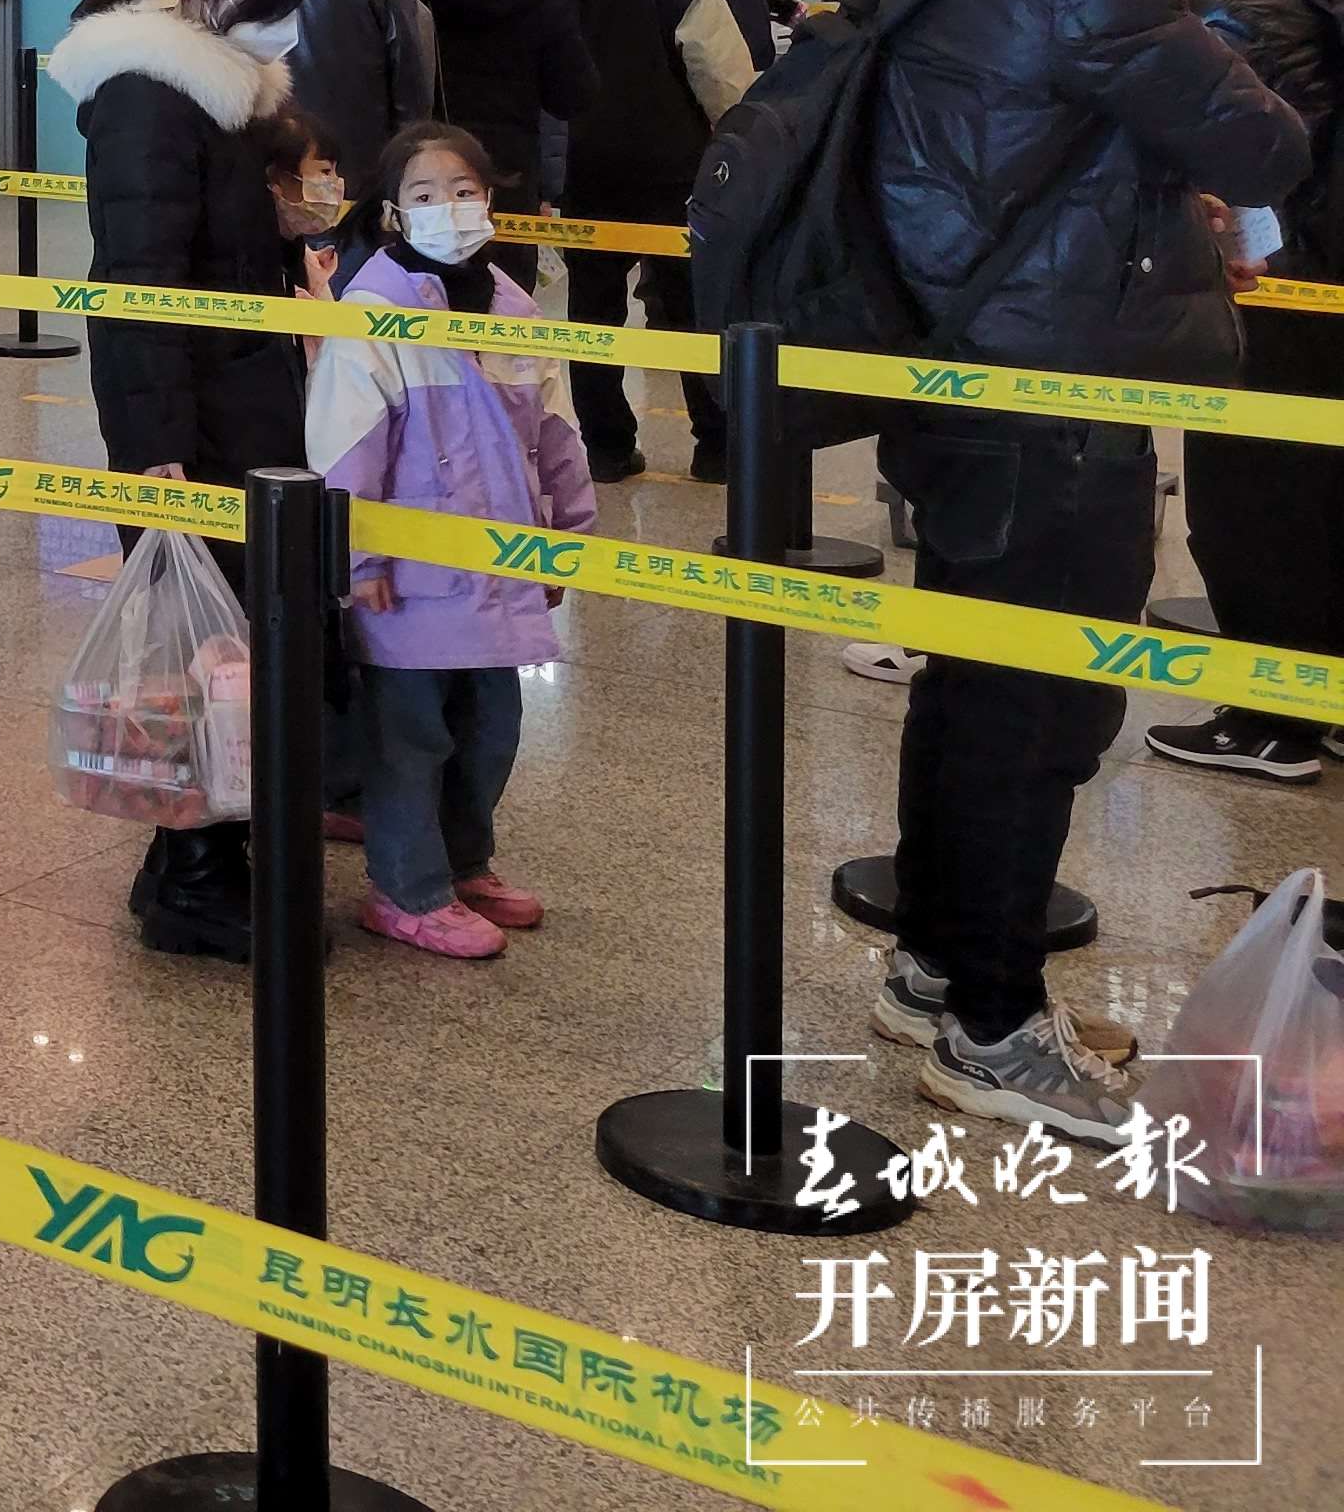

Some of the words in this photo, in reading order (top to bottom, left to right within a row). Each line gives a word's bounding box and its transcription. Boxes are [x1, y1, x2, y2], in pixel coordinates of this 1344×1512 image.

[123, 290, 266, 316] 昆明长水国际机场
[447, 318, 616, 347] 昆明长水国际机场
[1013, 377, 1228, 413] 昆明长水国际机场
[35, 473, 241, 516] 昆明长水国际机场
[615, 550, 882, 612] 昆明长水国际机场
[258, 1246, 783, 1446] 昆明长水国际机场
[257, 1299, 353, 1343] KUNMING
[356, 1333, 486, 1388] CHANGSHUI
[487, 1376, 670, 1452] INTERNATIONAL
[674, 1440, 784, 1487] AIRPORT
